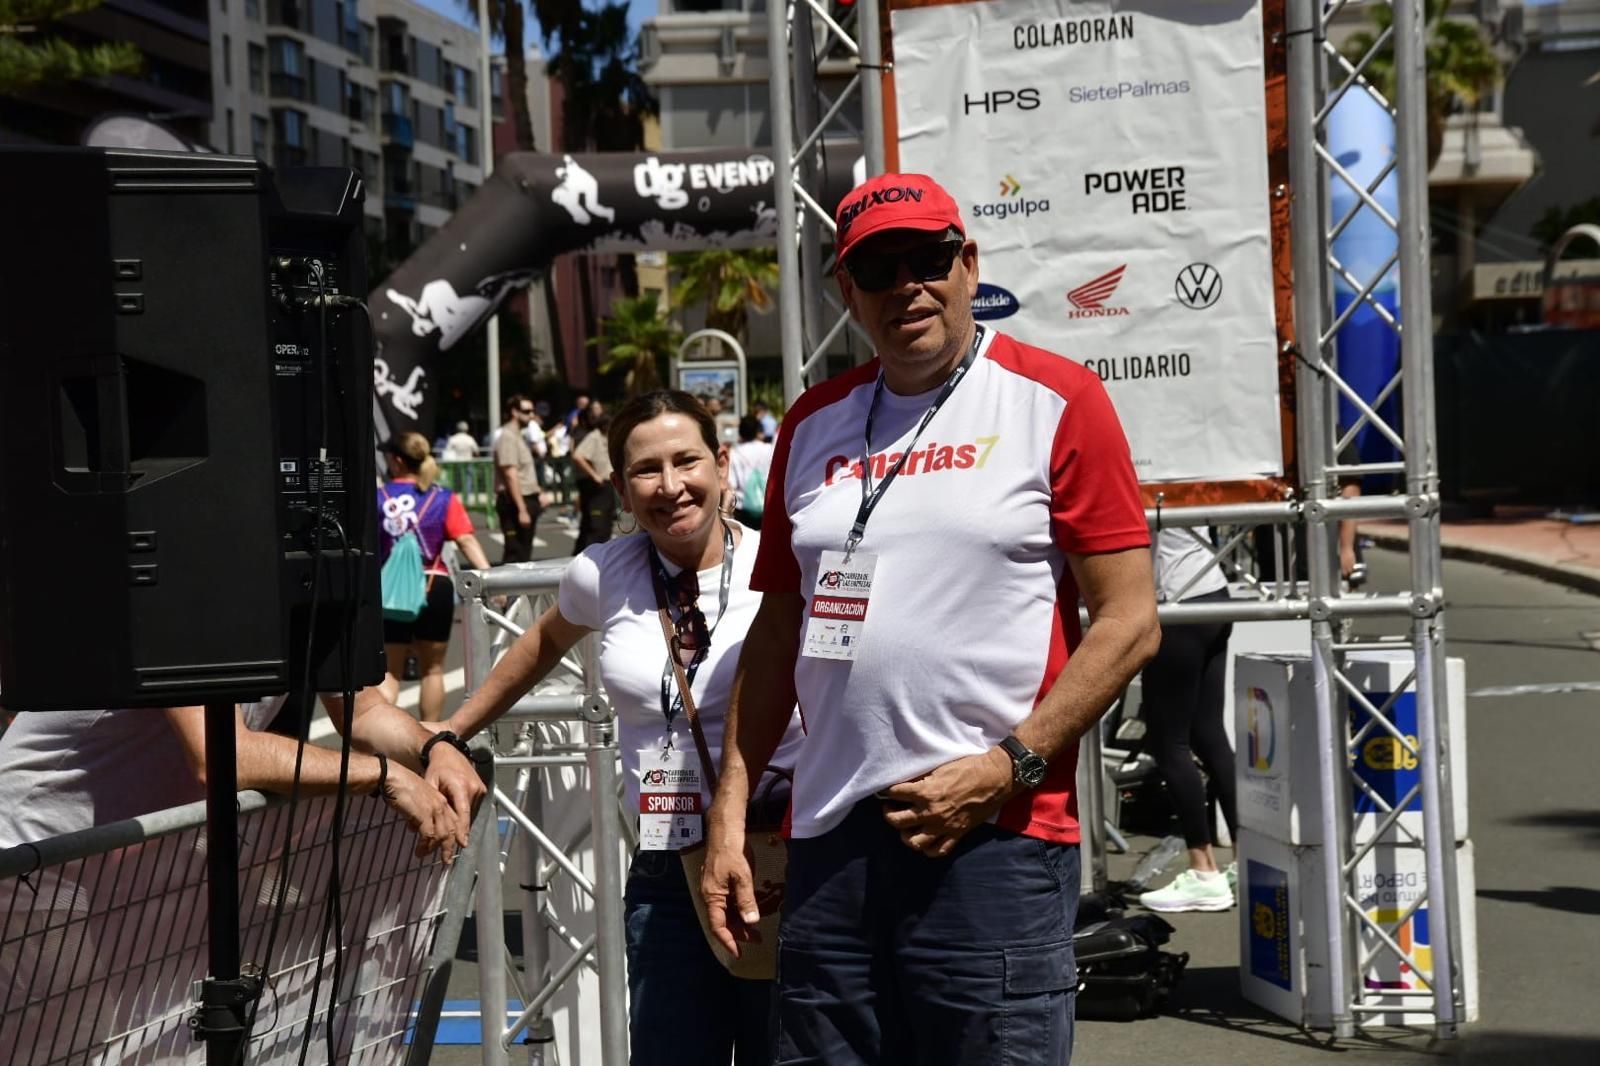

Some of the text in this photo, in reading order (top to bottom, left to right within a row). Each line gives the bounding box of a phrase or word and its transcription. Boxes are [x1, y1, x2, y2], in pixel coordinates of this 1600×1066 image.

[1013, 15, 1134, 50] COLABORAN
[963, 88, 1041, 115] HPS
[1069, 80, 1191, 103] SietePalmas
[634, 156, 775, 209] dg EVENT
[1085, 166, 1186, 195] POWER
[973, 197, 1050, 219] sagulpa
[1068, 306, 1130, 319] HONDA
[814, 600, 865, 616] ORGANIZACIÓN
[647, 796, 694, 812] SPONSOR
[1359, 872, 1417, 888] DEPOR
